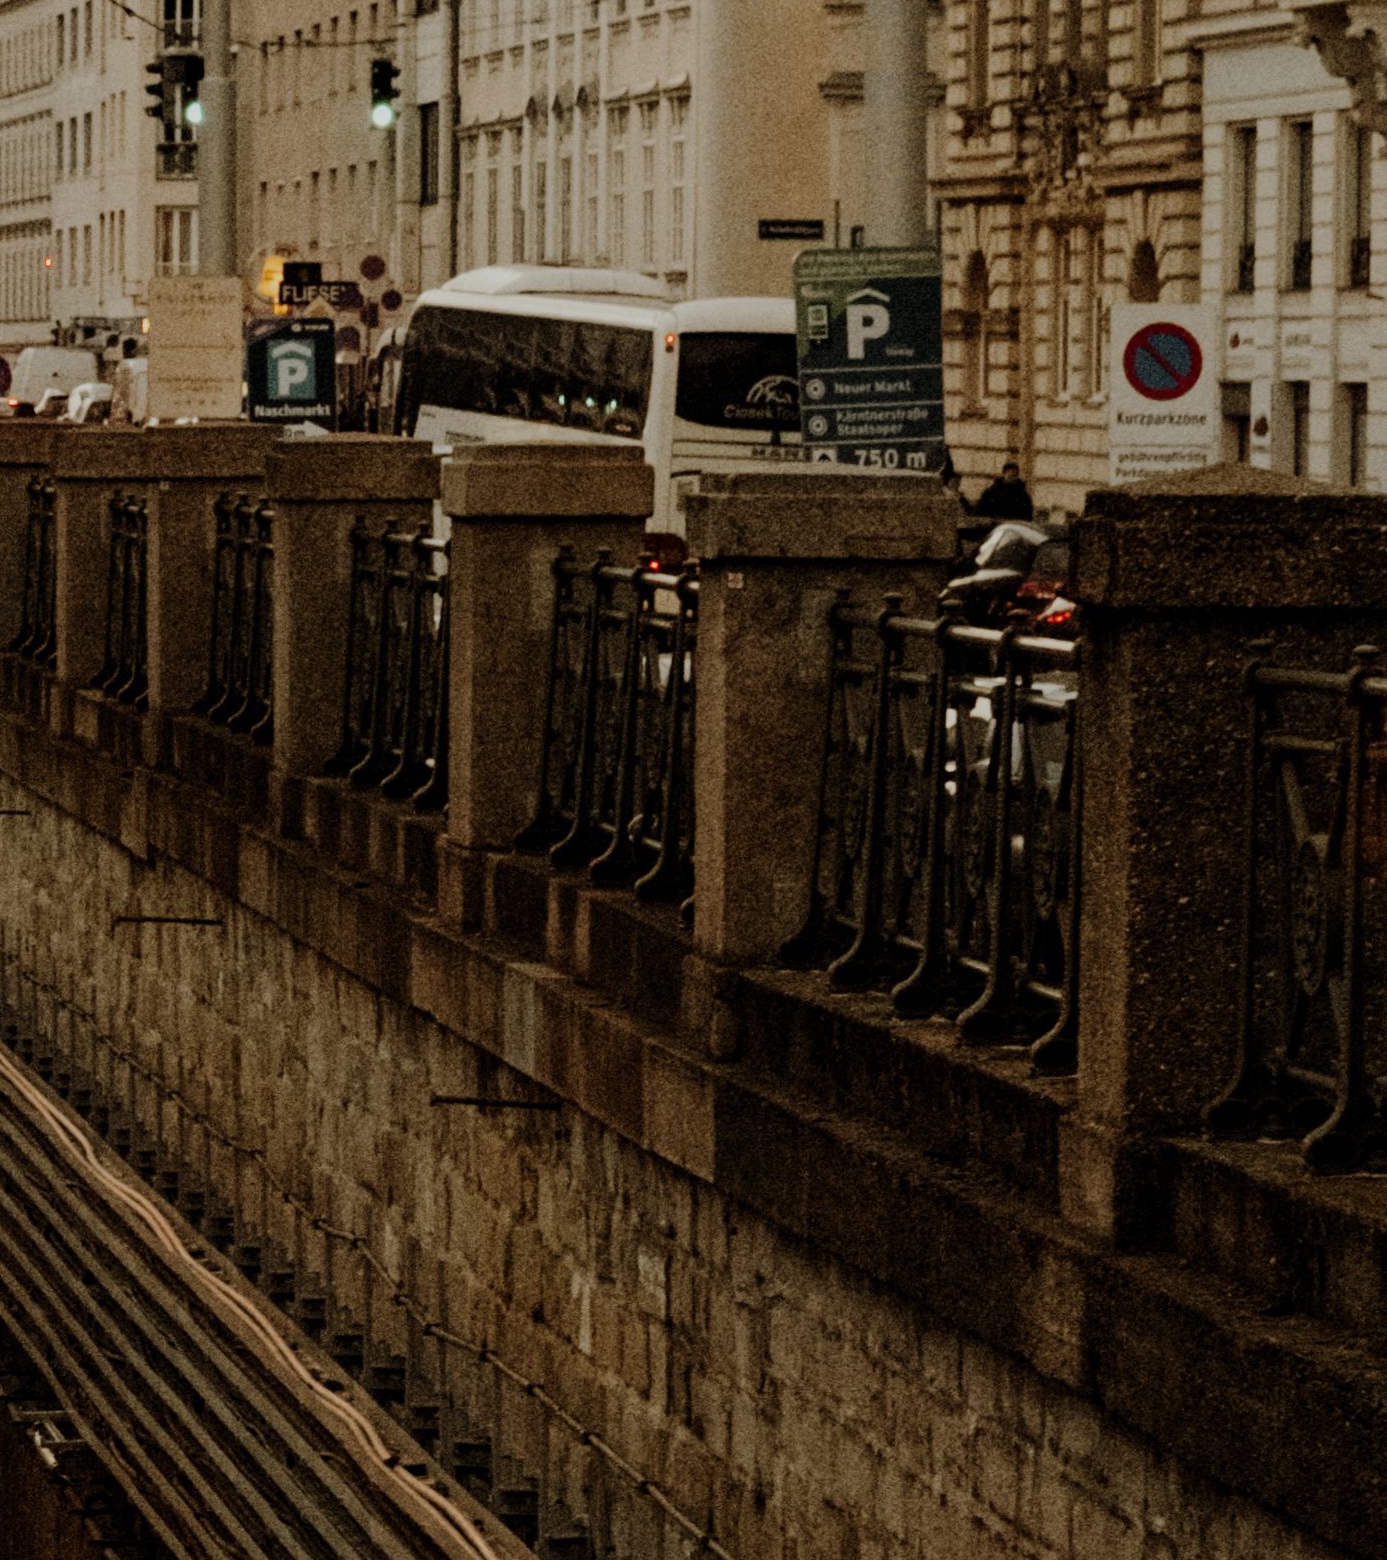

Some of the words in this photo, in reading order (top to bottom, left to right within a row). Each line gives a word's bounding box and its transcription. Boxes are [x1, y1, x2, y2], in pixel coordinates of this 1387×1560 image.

[282, 285, 347, 303] FLIESE
[833, 381, 872, 395] Neuer
[874, 379, 912, 393] Markt
[254, 403, 331, 418] Naschmarkt
[1117, 412, 1207, 426] Kurzparkzone
[837, 424, 904, 437] Staatsoper
[854, 448, 899, 468] 750
[906, 451, 927, 469] m
